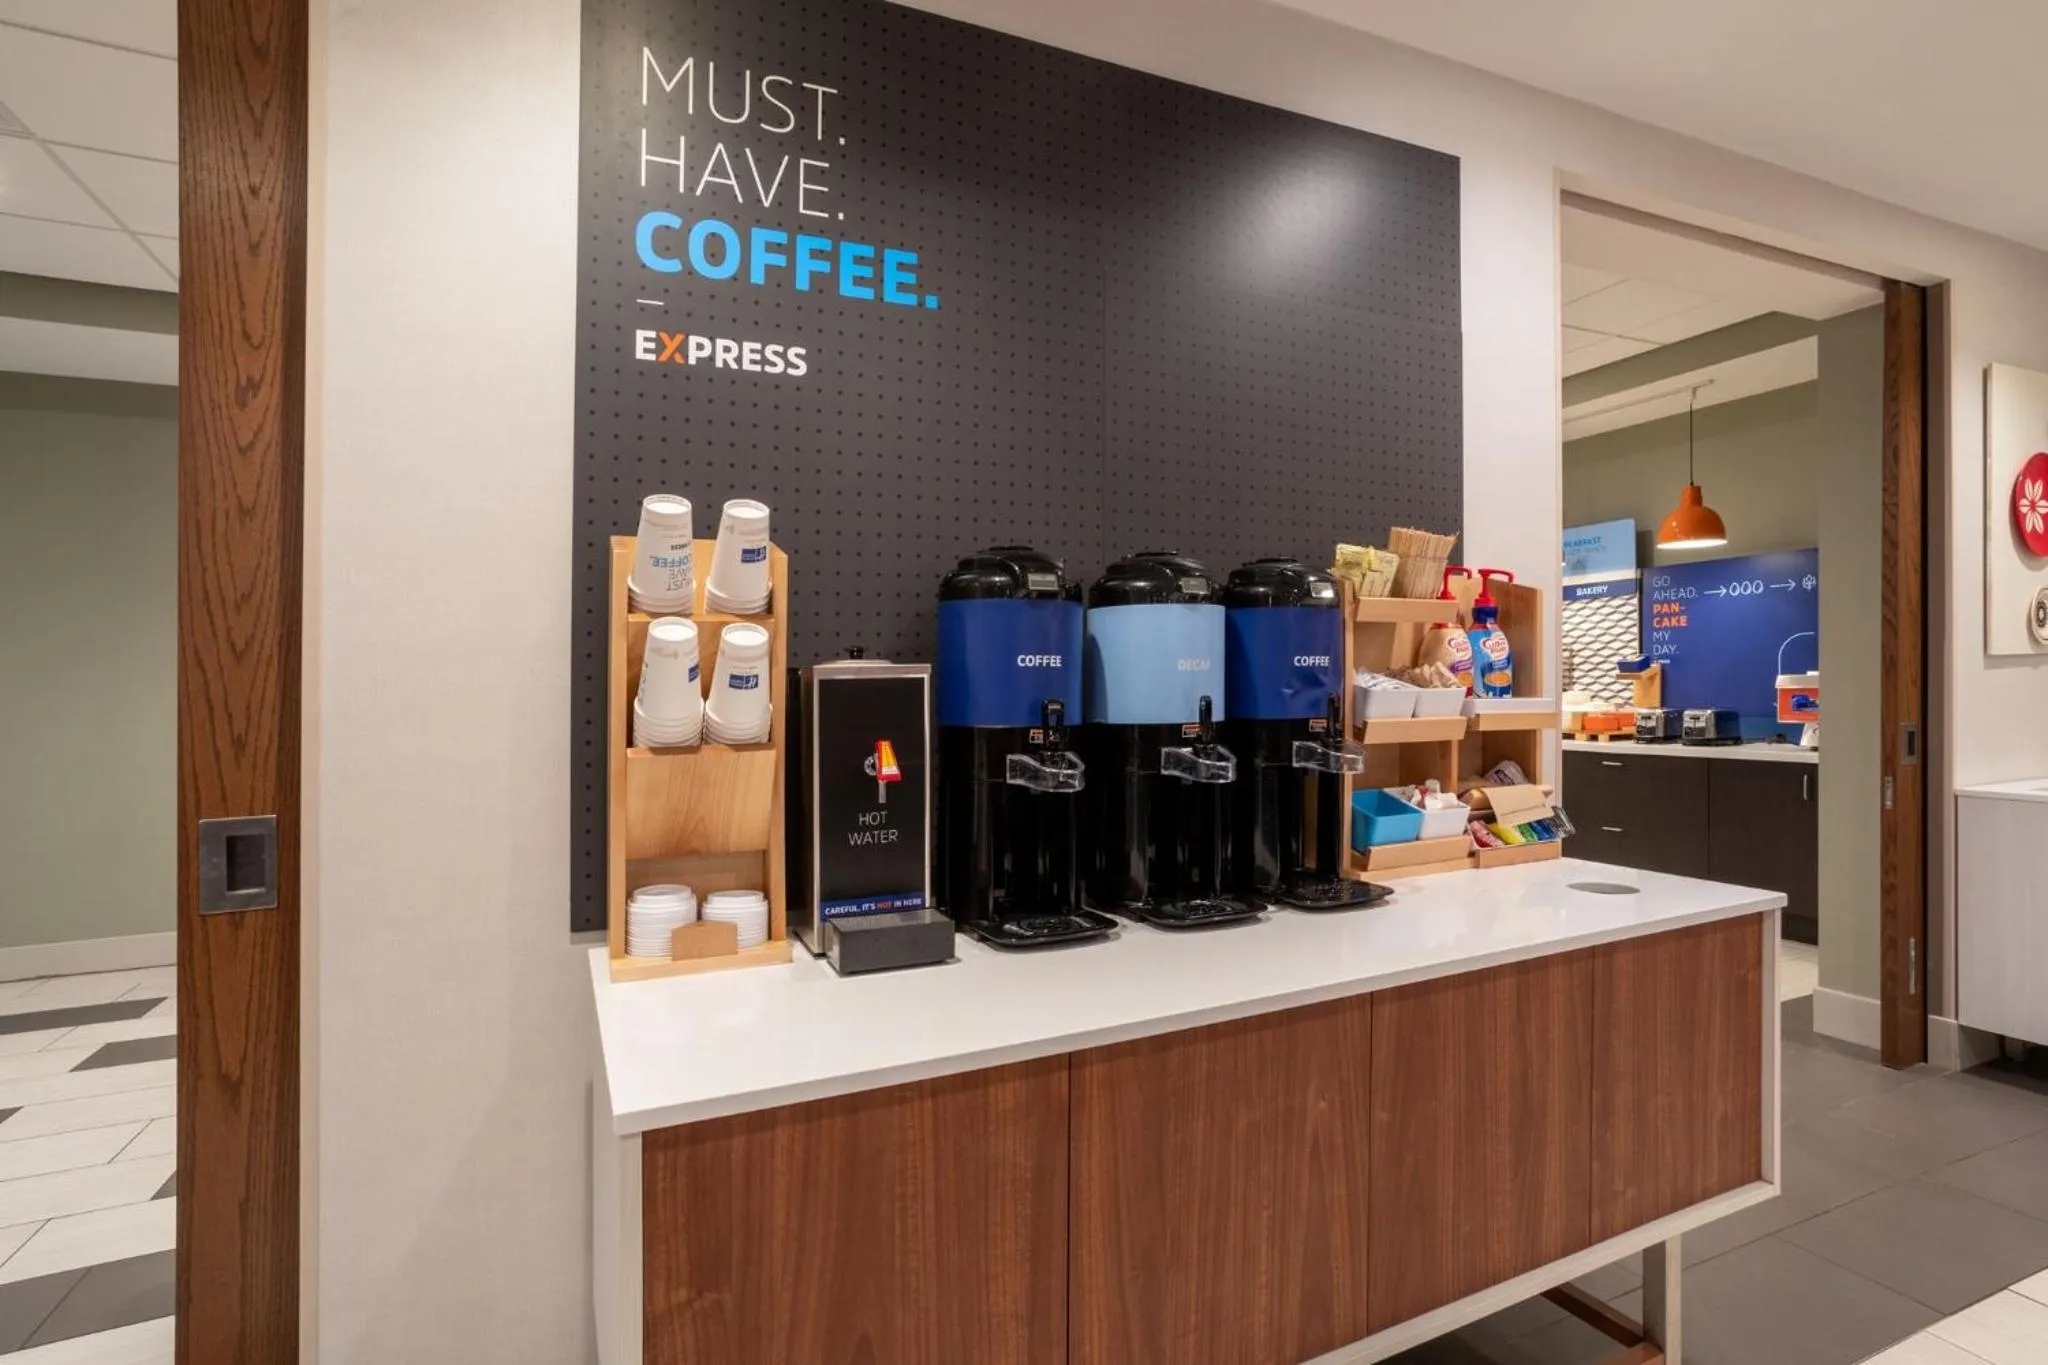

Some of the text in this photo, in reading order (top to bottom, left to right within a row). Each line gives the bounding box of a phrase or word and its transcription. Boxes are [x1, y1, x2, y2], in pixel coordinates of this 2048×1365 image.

[642, 46, 846, 145] MUST.
[641, 128, 845, 220] HAVE.
[635, 211, 939, 309] COFFEE.
[635, 329, 808, 376] EXPRESS
[1652, 575, 1671, 587] GO
[1576, 585, 1608, 596] BAKERY
[1652, 586, 1698, 600] AHEAD.
[1653, 601, 1686, 615] PAN-
[1653, 615, 1688, 628] CAKE
[1653, 630, 1671, 642] MY
[1652, 643, 1680, 655] DAY.
[1017, 654, 1062, 667] COFFEE
[1294, 655, 1330, 667] COFFEE
[858, 811, 888, 825] HOT
[848, 829, 898, 846] WATER
[877, 901, 892, 910] HOT
[894, 899, 902, 908] IN
[903, 898, 922, 906] HERE
